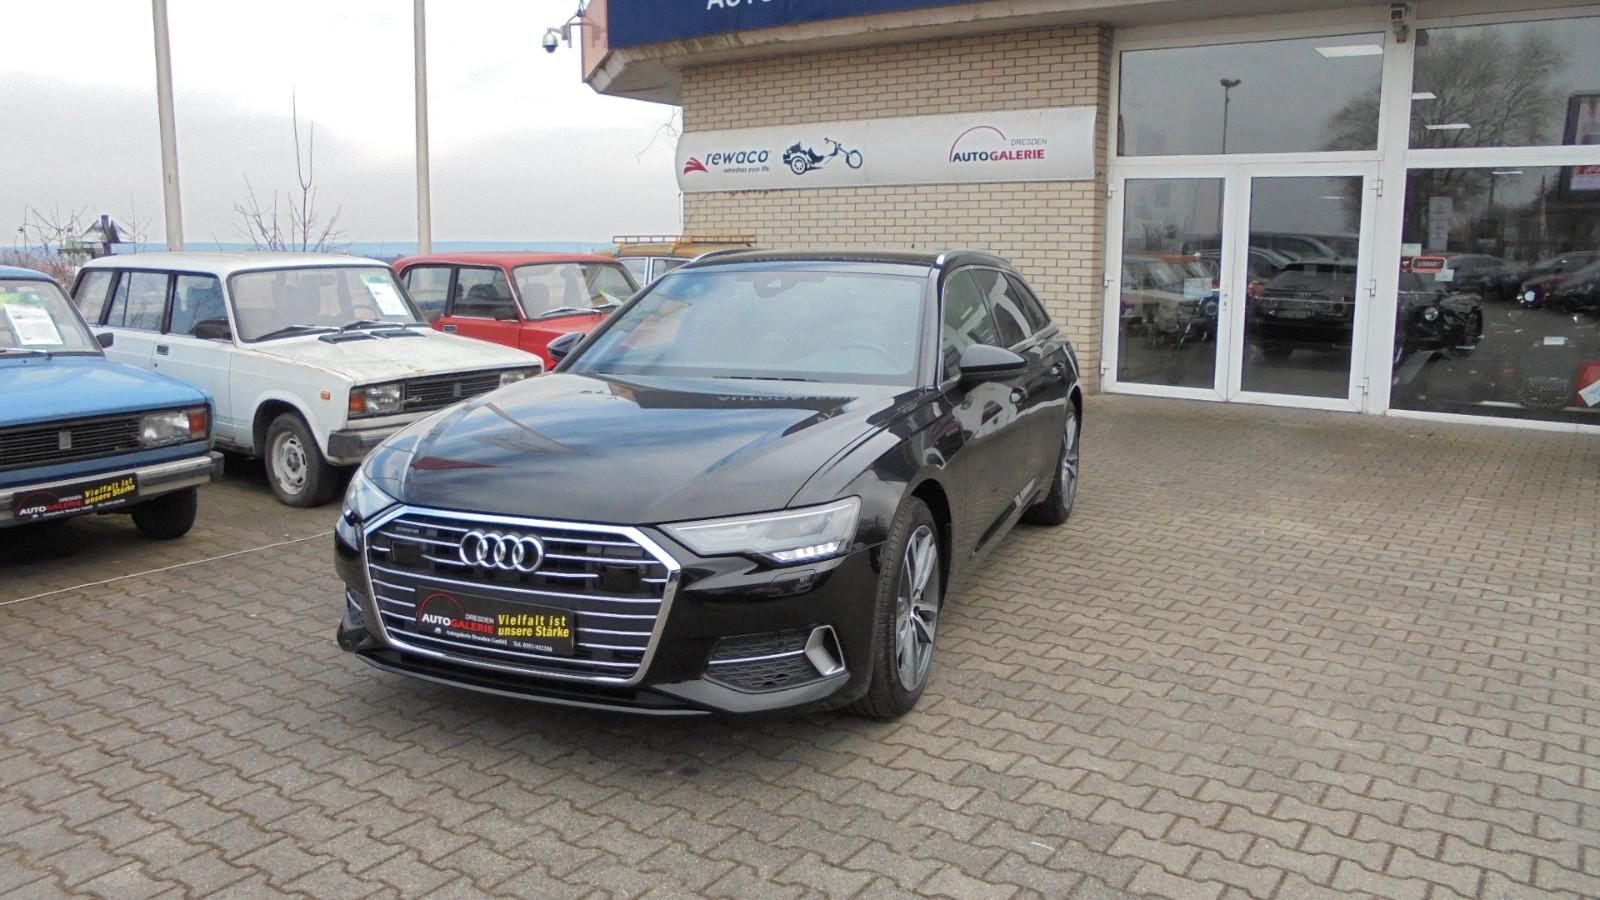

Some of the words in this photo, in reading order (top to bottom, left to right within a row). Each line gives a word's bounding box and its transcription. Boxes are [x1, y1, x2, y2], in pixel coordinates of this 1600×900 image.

[1010, 138, 1047, 146] DRESDEN
[706, 150, 769, 166] rewaco
[953, 149, 1045, 162] AUTOGALERIE
[85, 482, 118, 498] Vielfalt
[121, 477, 133, 487] ist
[421, 613, 496, 635] AUTOGALERIE
[465, 613, 495, 624] DRESDEN
[498, 614, 545, 626] Vielfalt
[549, 615, 567, 627] ist
[498, 627, 533, 637] unsere
[535, 626, 570, 638] Stärke
